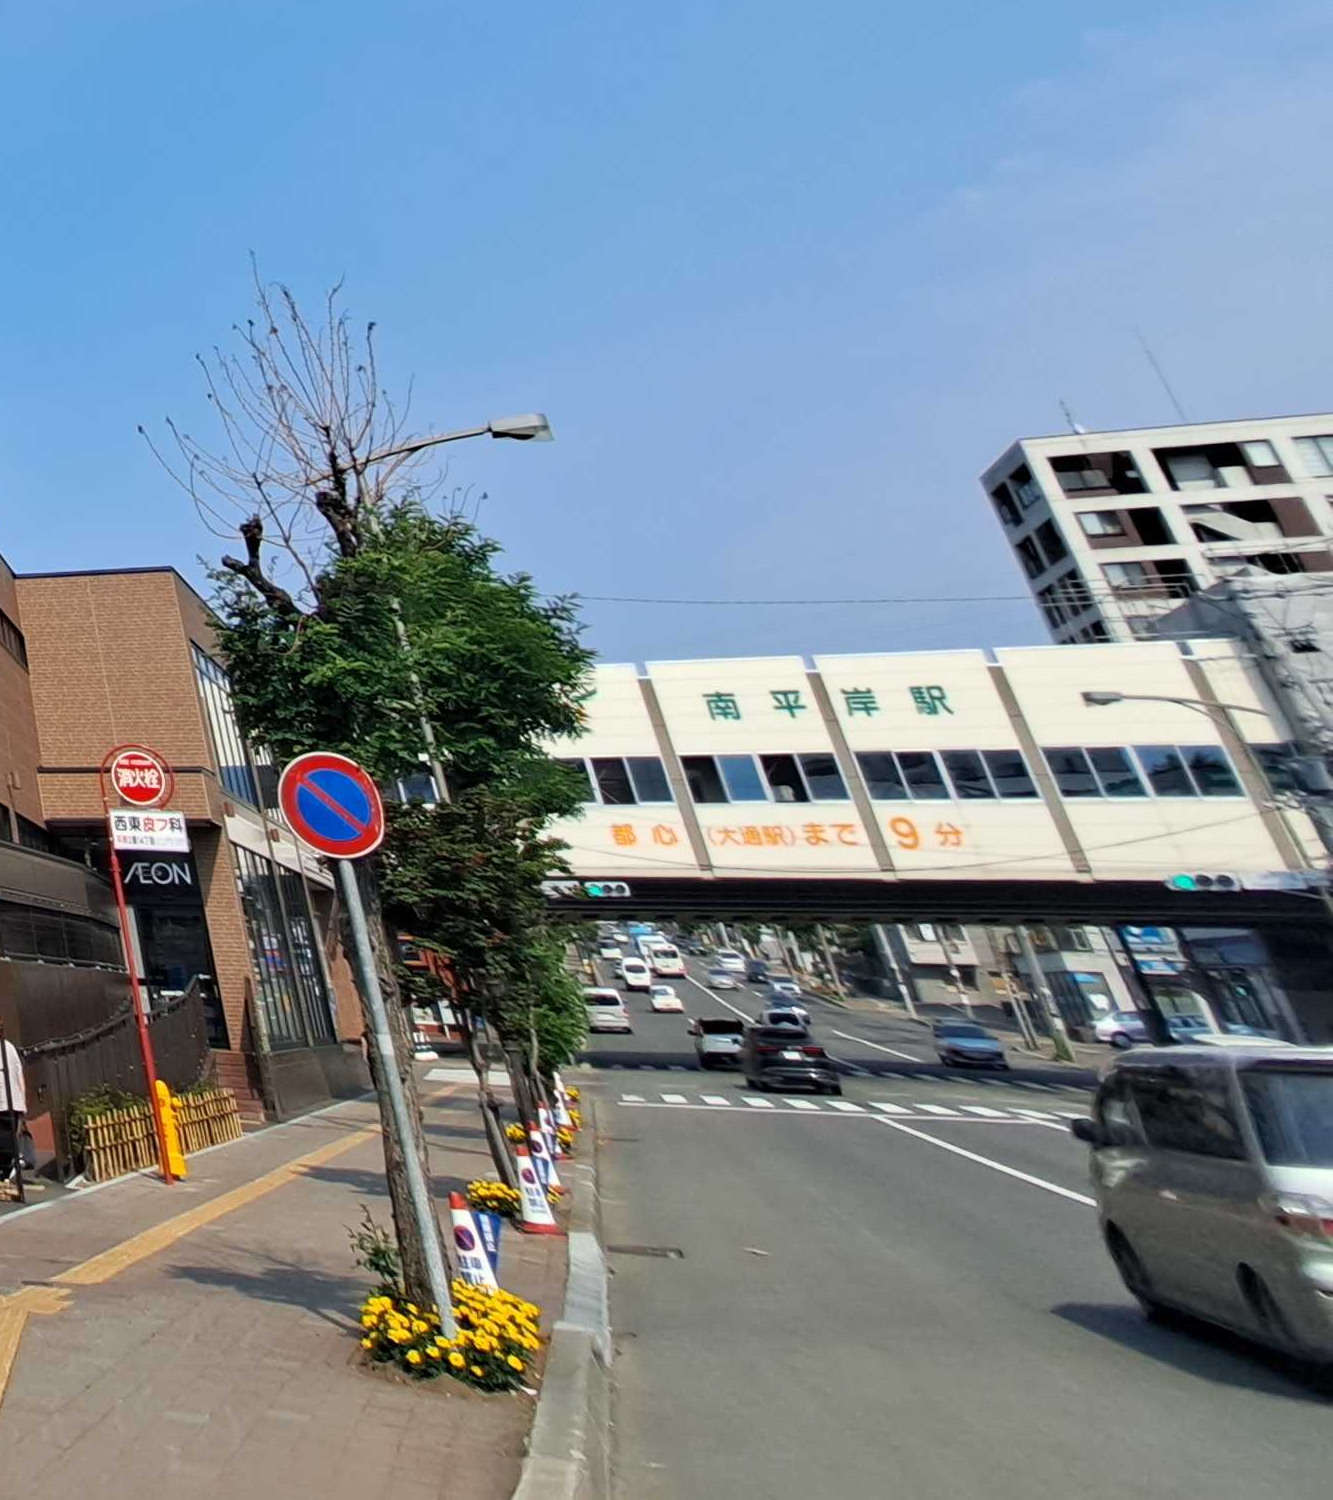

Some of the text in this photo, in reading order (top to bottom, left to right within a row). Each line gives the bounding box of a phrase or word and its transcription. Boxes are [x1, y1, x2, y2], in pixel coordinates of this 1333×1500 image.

[701, 685, 955, 722] 南平岸駅
[116, 767, 161, 789] 消火栓
